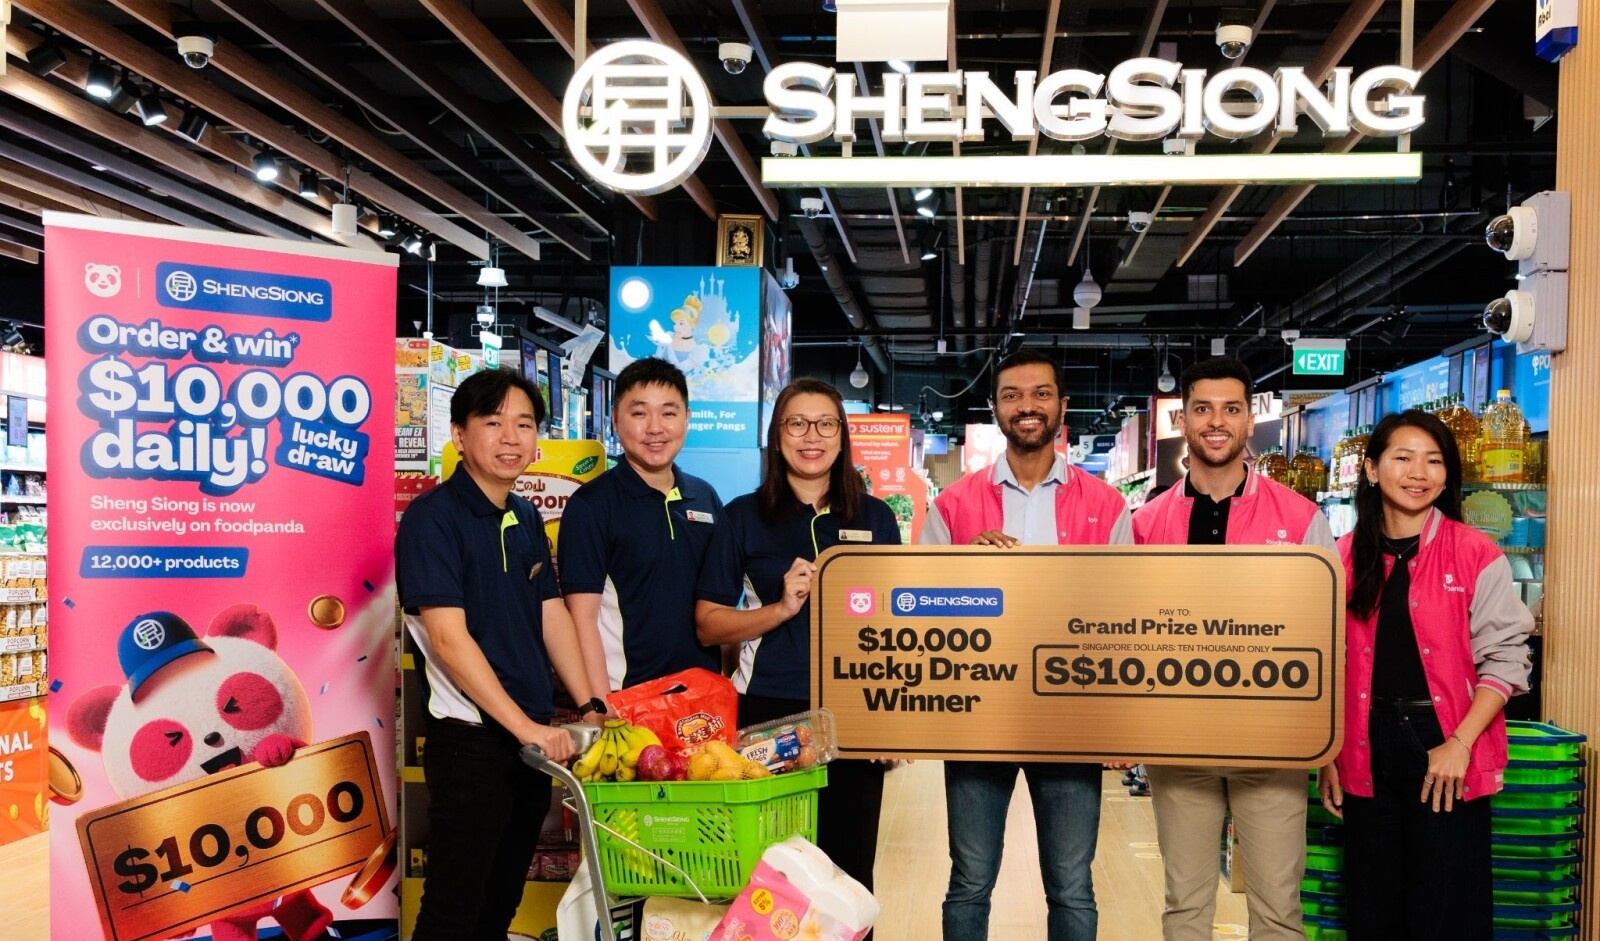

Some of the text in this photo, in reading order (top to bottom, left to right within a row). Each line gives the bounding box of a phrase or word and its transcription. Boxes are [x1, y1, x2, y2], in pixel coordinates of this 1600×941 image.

[202, 280, 324, 305] SHENGSIONG
[88, 318, 197, 352] Order
[202, 328, 228, 354] &
[1307, 354, 1340, 371] EXIT
[88, 356, 370, 427] $10,000
[720, 410, 736, 418] For
[716, 422, 746, 431] Pangs
[860, 424, 904, 433] sustenir
[291, 422, 358, 458] lucky
[399, 438, 426, 448] REVEAL
[92, 416, 267, 487] daily!
[287, 445, 356, 476] draw
[90, 496, 255, 514] Sheng Siong is now
[90, 517, 305, 536] exclusively on foodpanda
[91, 555, 239, 572] 12,000+ products
[920, 596, 997, 606] SHENGSIONG
[1068, 618, 1285, 636] Grand Prize Winner
[858, 625, 992, 657] $10,000
[833, 656, 1018, 687] Lucky Draw
[1045, 654, 1309, 692] S$10,000.00
[863, 687, 981, 713] Winner
[747, 747, 768, 760] FRESH
[749, 755, 767, 764] GGS
[113, 780, 364, 898] $10,000
[753, 891, 766, 905] EXTRA
[759, 898, 771, 910] 5%
